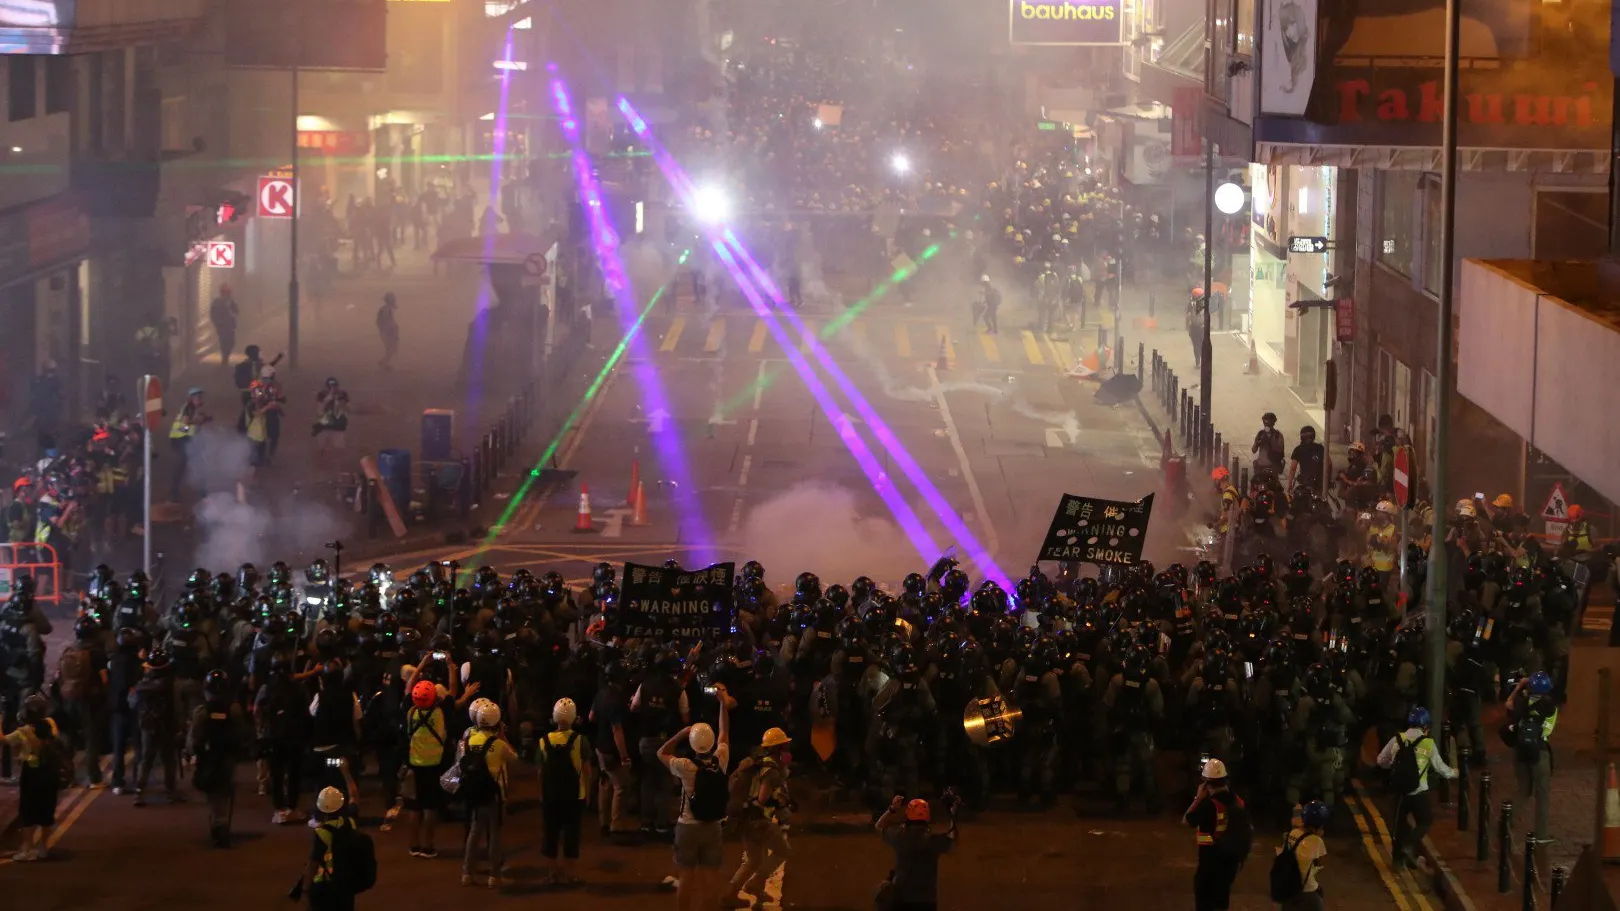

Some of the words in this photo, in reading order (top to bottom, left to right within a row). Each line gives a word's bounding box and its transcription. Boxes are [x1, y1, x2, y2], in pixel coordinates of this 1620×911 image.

[1021, 1, 1115, 20] bauhaus
[1335, 77, 1598, 127] Takumi
[1066, 499, 1093, 520] 警告
[1067, 524, 1125, 537] WRNING
[1047, 546, 1080, 558] TEAR
[1086, 547, 1132, 564] SMOKE
[632, 566, 664, 585] 警告
[640, 599, 709, 615] WARNING
